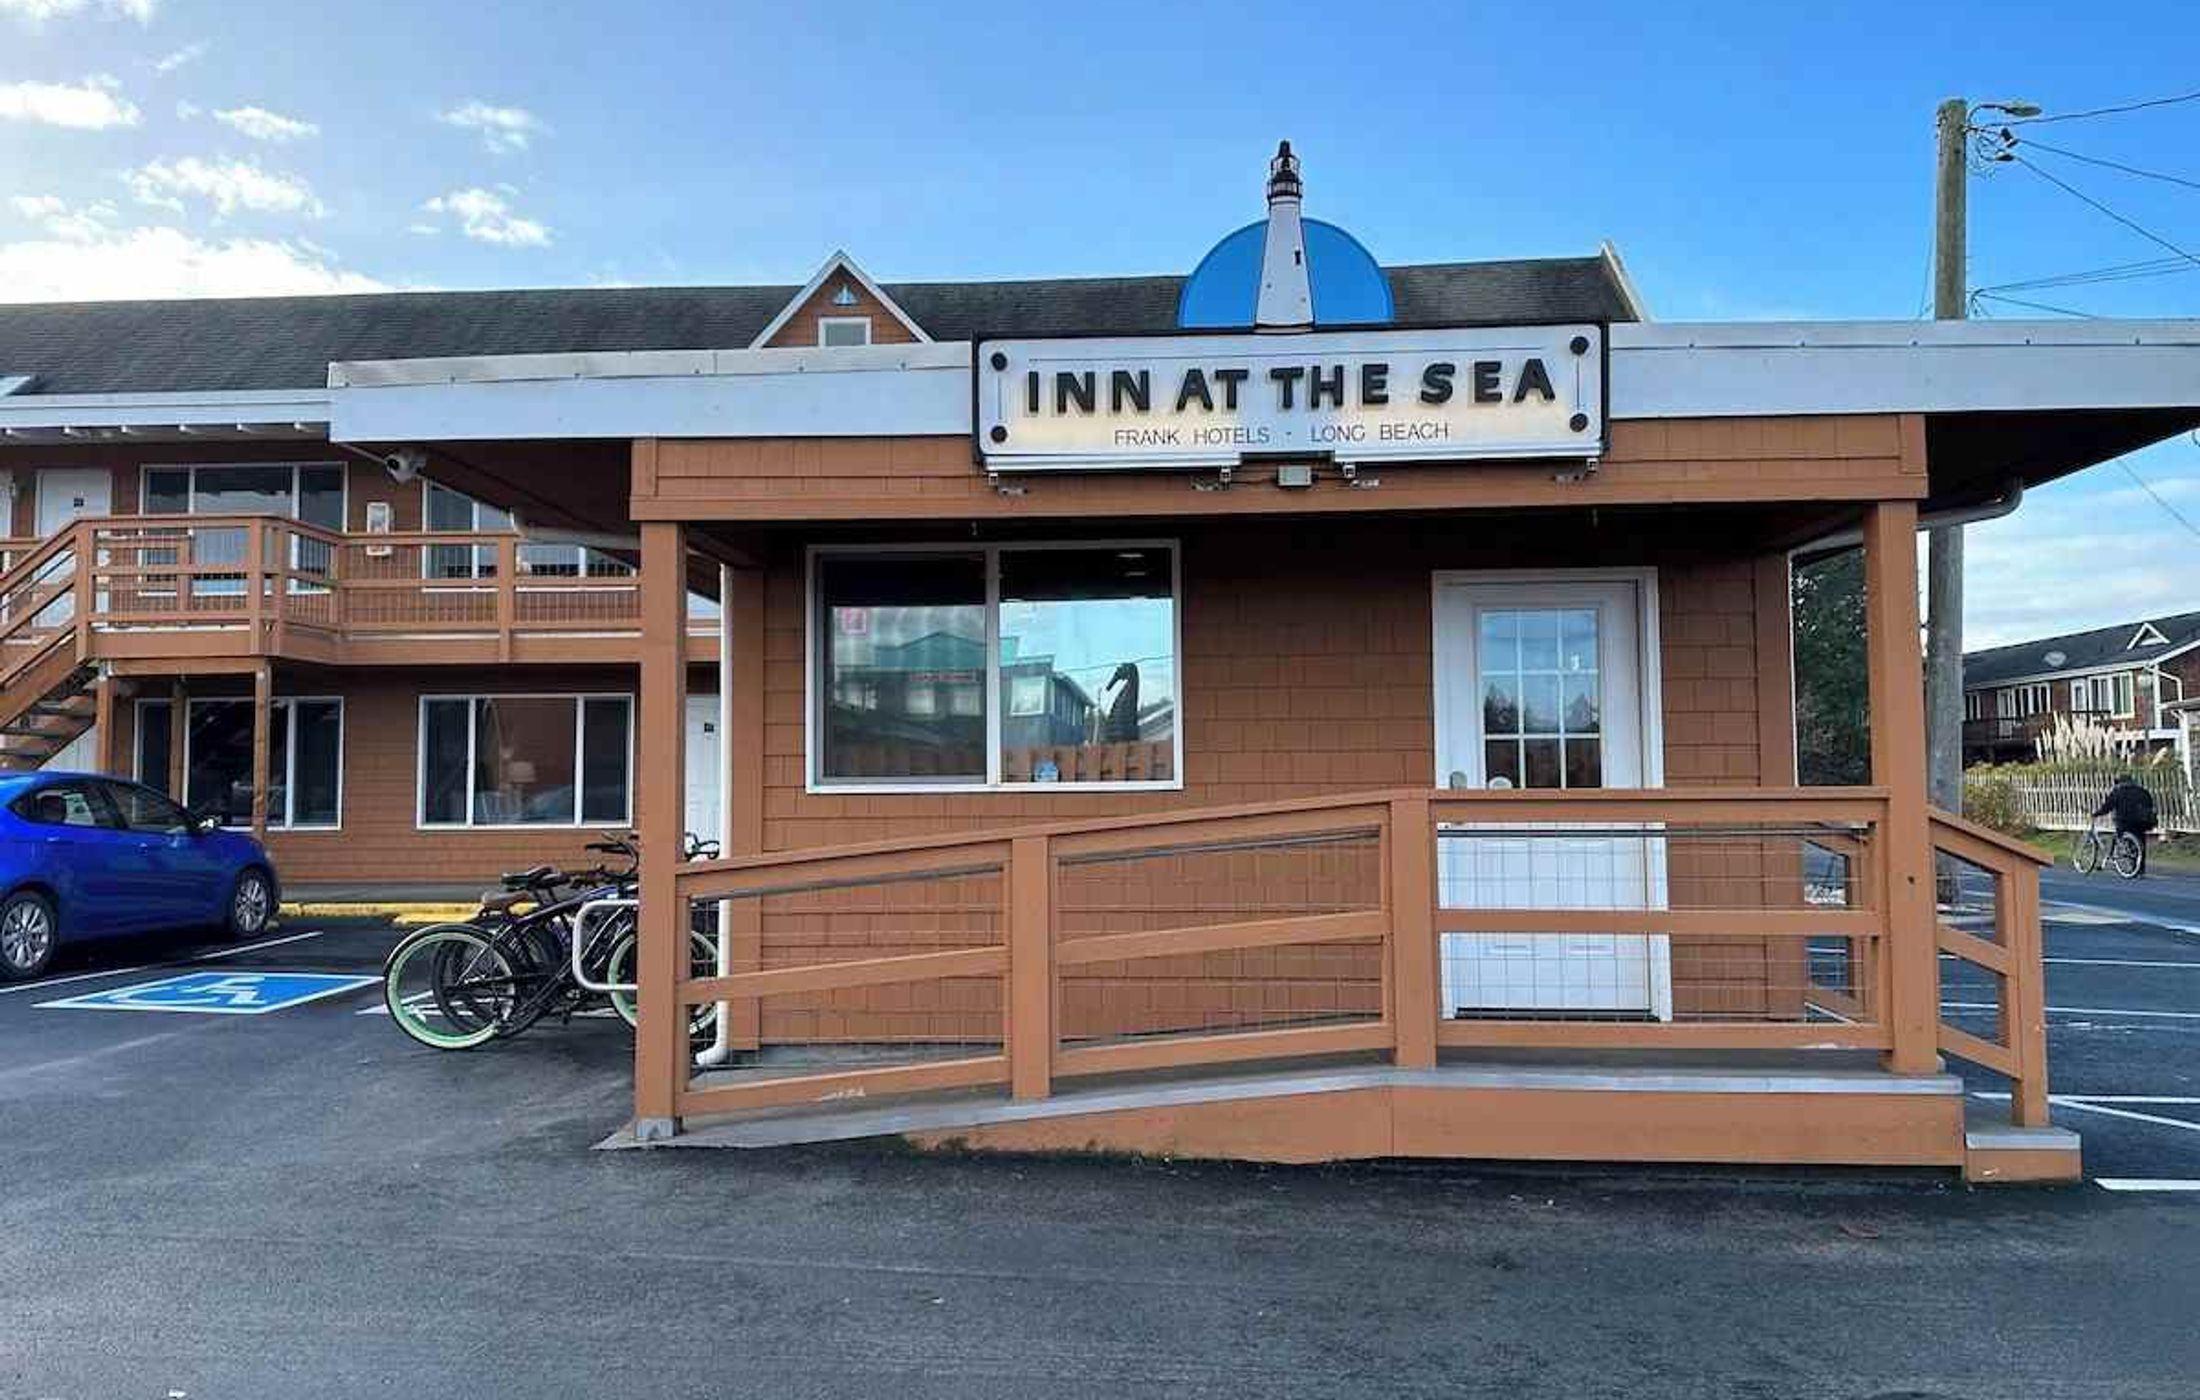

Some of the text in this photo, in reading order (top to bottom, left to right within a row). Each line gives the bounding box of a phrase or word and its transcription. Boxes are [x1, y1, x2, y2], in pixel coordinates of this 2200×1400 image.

[1027, 358, 1556, 414] INN AT THE SEA
[1114, 422, 1449, 445] FRANK HOTELS LONG BEACH
